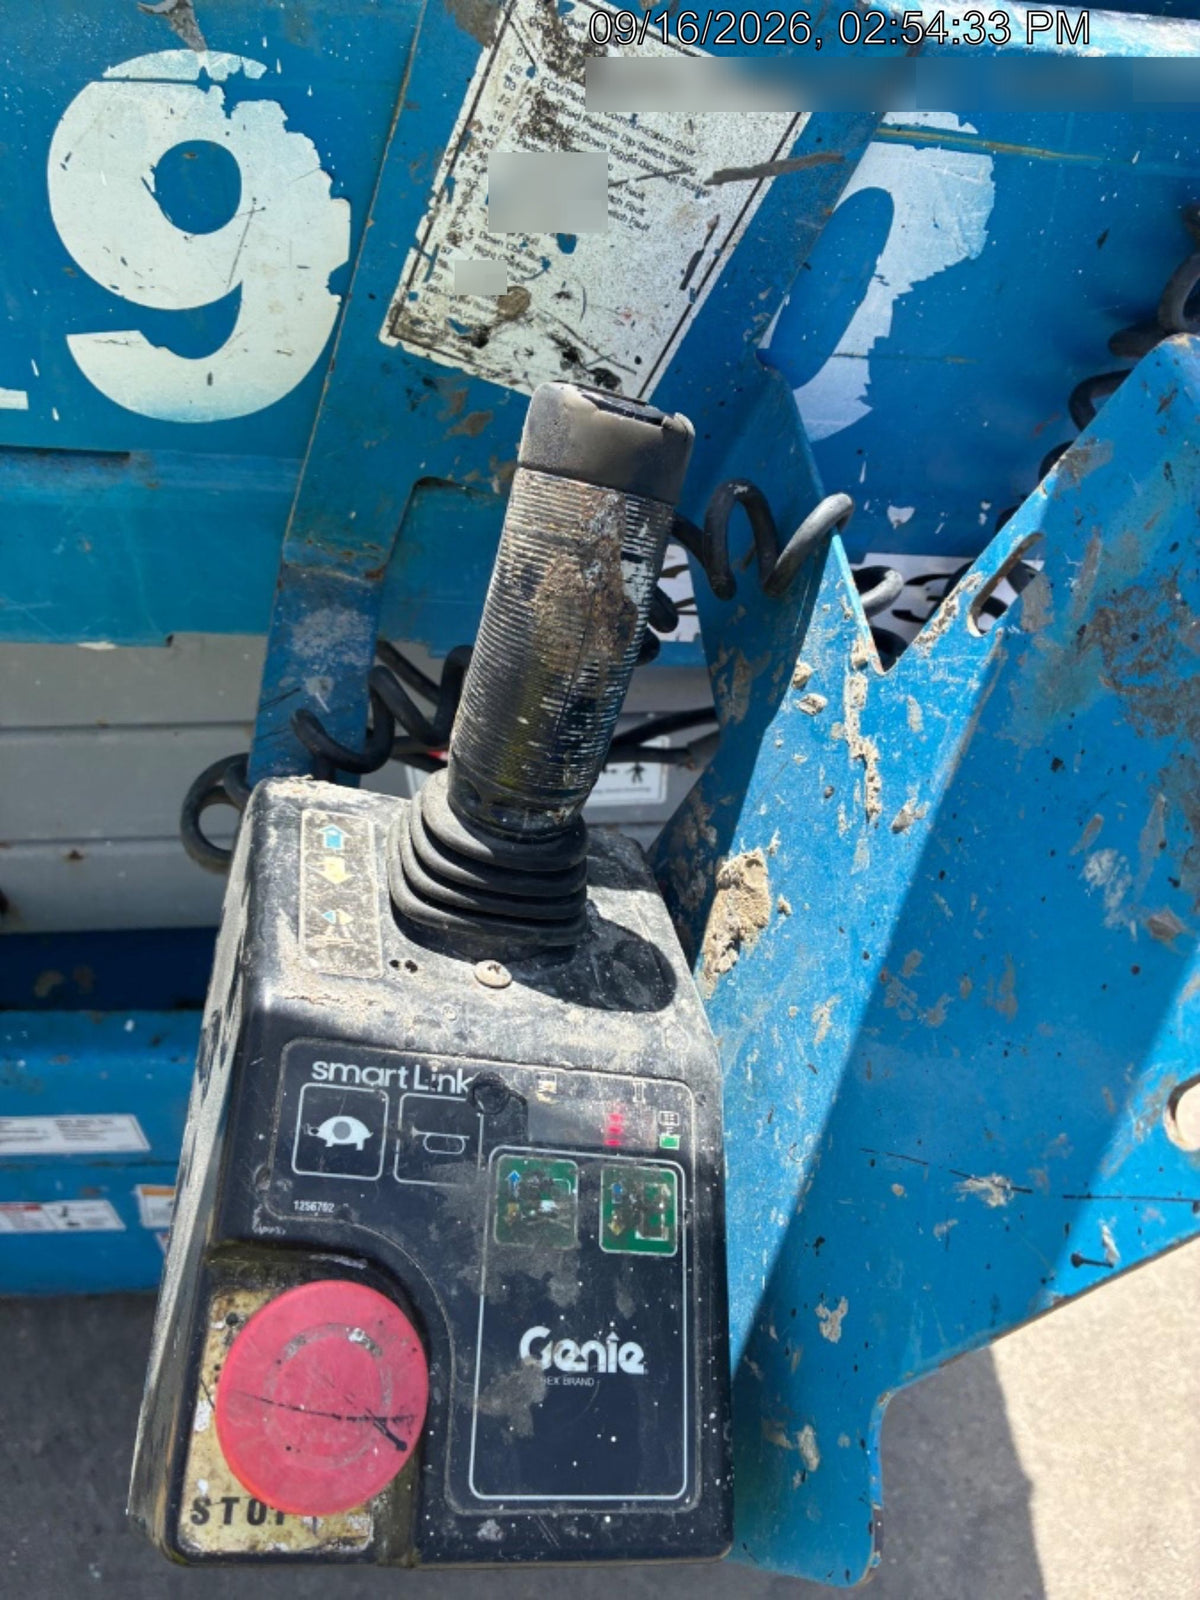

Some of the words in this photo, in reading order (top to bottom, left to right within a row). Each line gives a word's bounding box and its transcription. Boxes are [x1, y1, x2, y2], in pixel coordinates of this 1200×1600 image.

[311, 1061, 408, 1089] smart
[519, 1325, 645, 1374] Genie
[562, 1376, 594, 1386] BRAND
